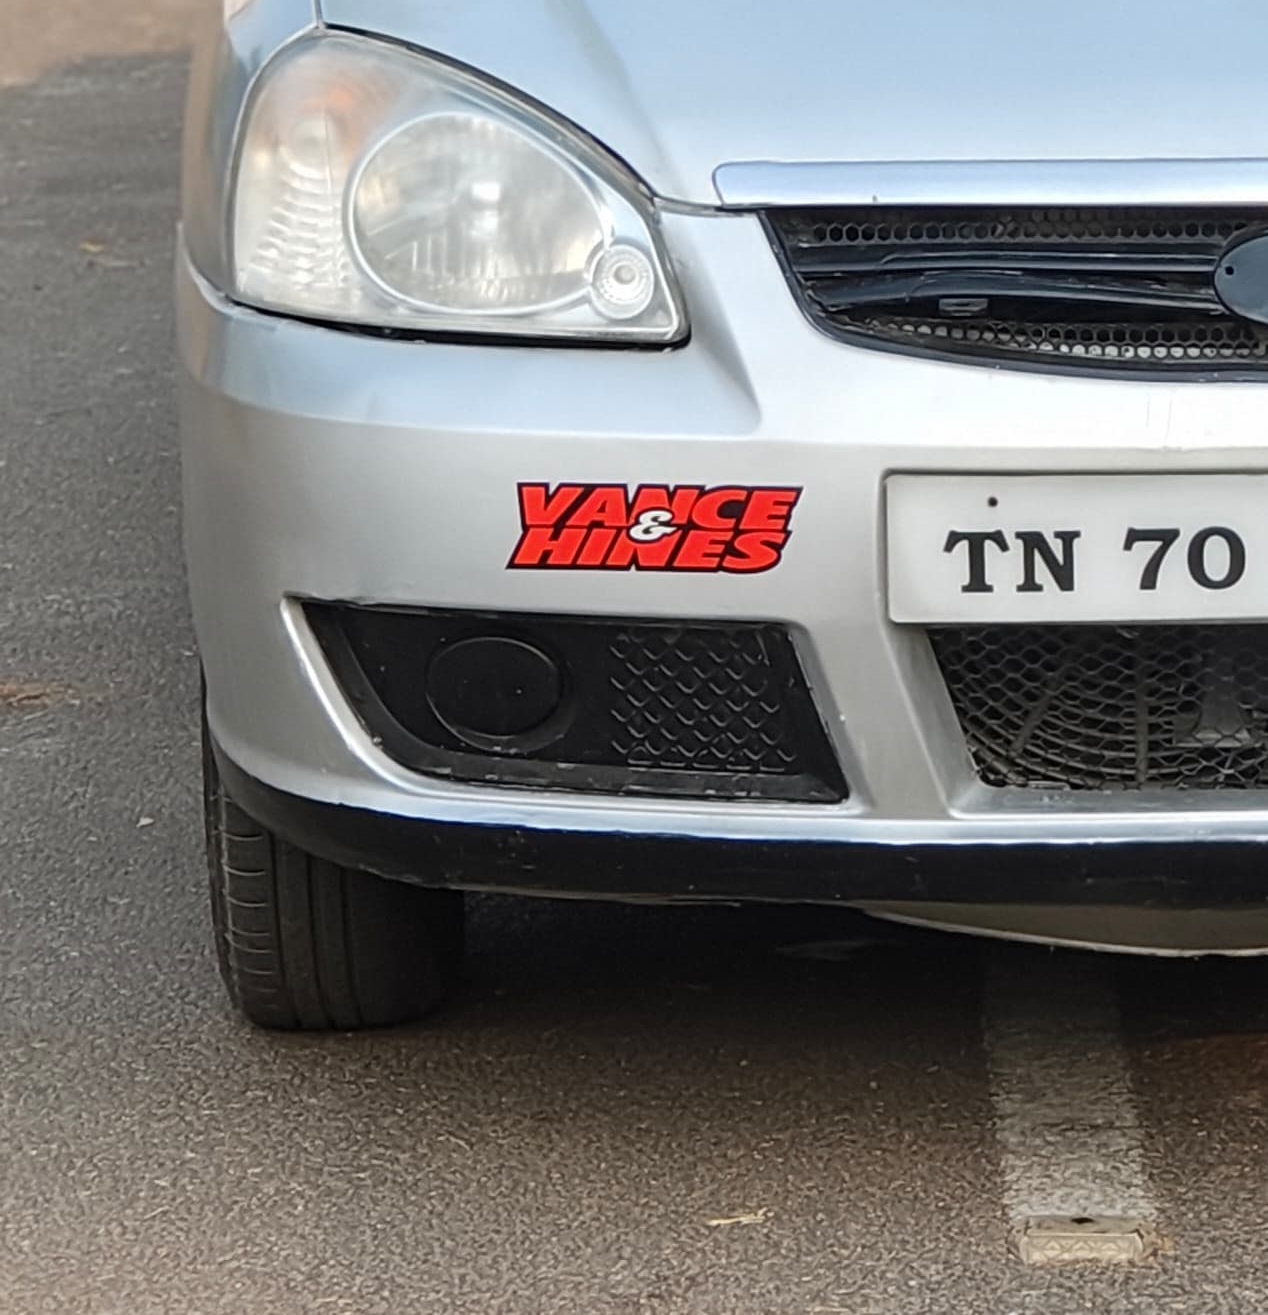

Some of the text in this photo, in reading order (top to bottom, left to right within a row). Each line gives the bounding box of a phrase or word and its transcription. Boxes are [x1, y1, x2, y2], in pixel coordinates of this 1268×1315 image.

[517, 483, 803, 530] VANCE
[629, 509, 676, 541] &
[506, 528, 792, 573] HINES
[943, 530, 1081, 593] TN
[1123, 526, 1246, 591] 70
